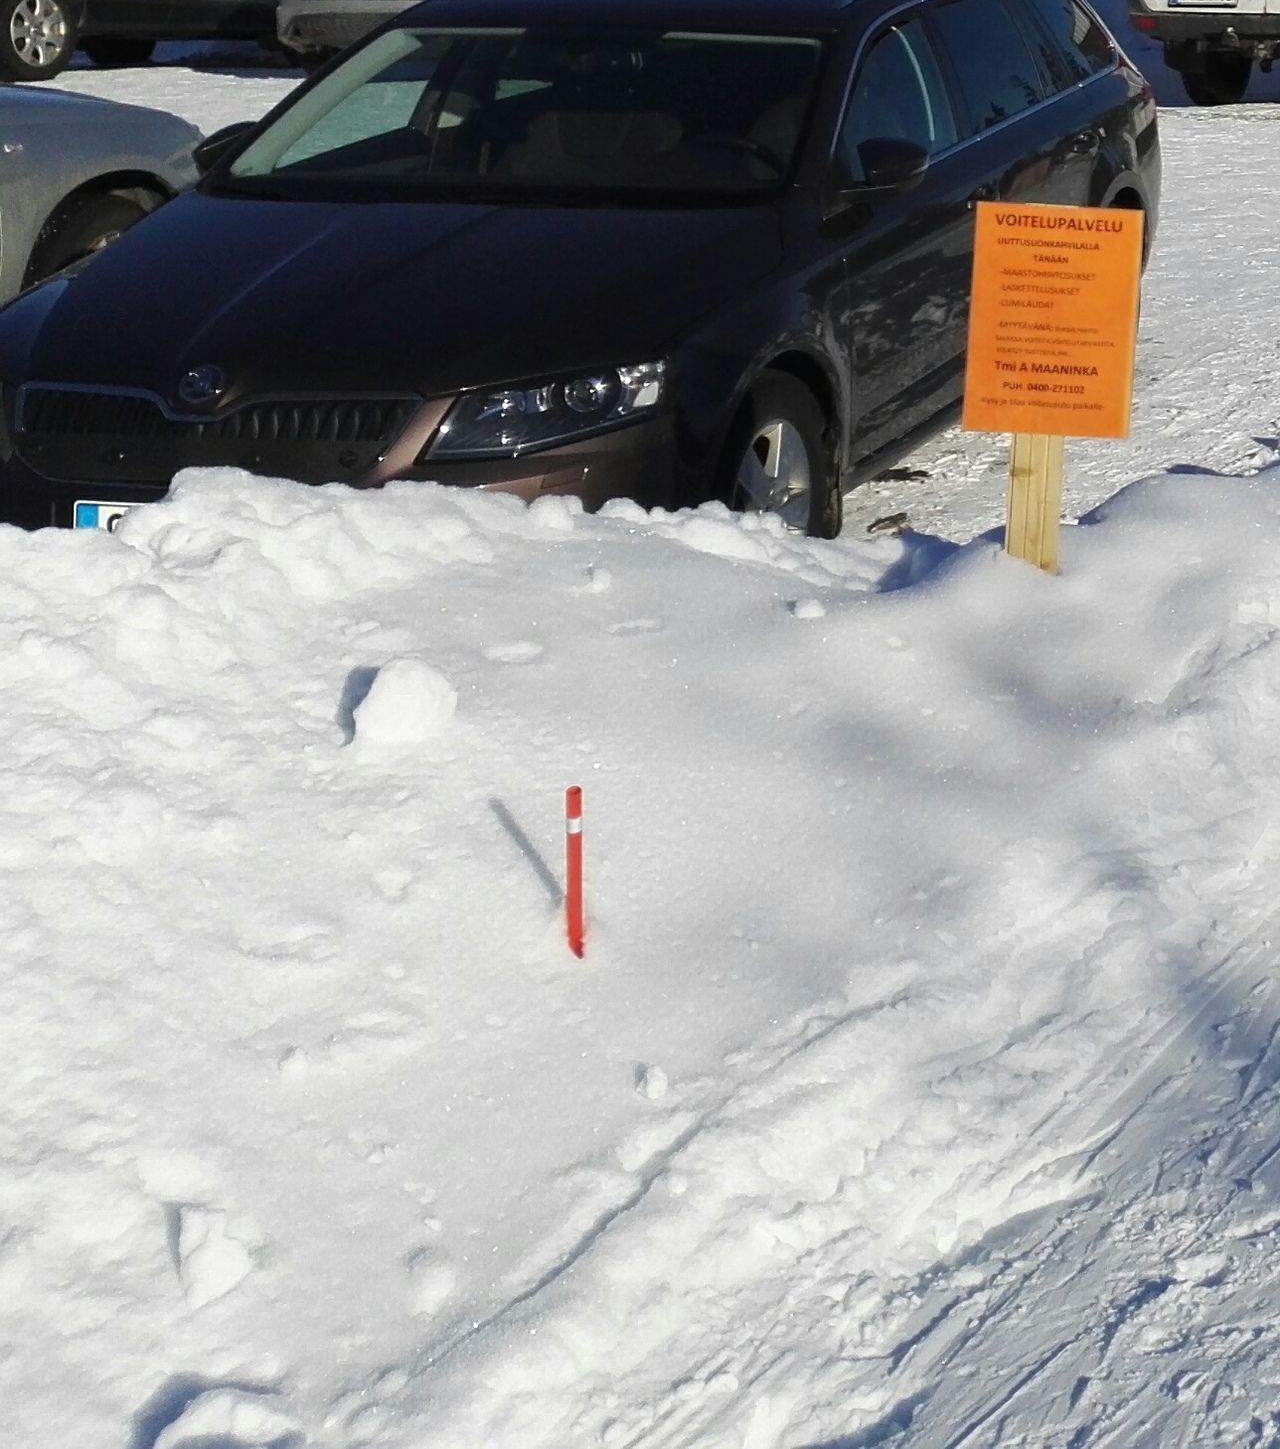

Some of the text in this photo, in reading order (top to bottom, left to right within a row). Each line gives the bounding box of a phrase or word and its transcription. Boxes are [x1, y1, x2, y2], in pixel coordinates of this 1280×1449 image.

[995, 213, 1123, 233] VOITELUPALVELU
[994, 360, 1099, 377] Tmi A MAANINKA
[1027, 383, 1086, 394] 0400-271102
